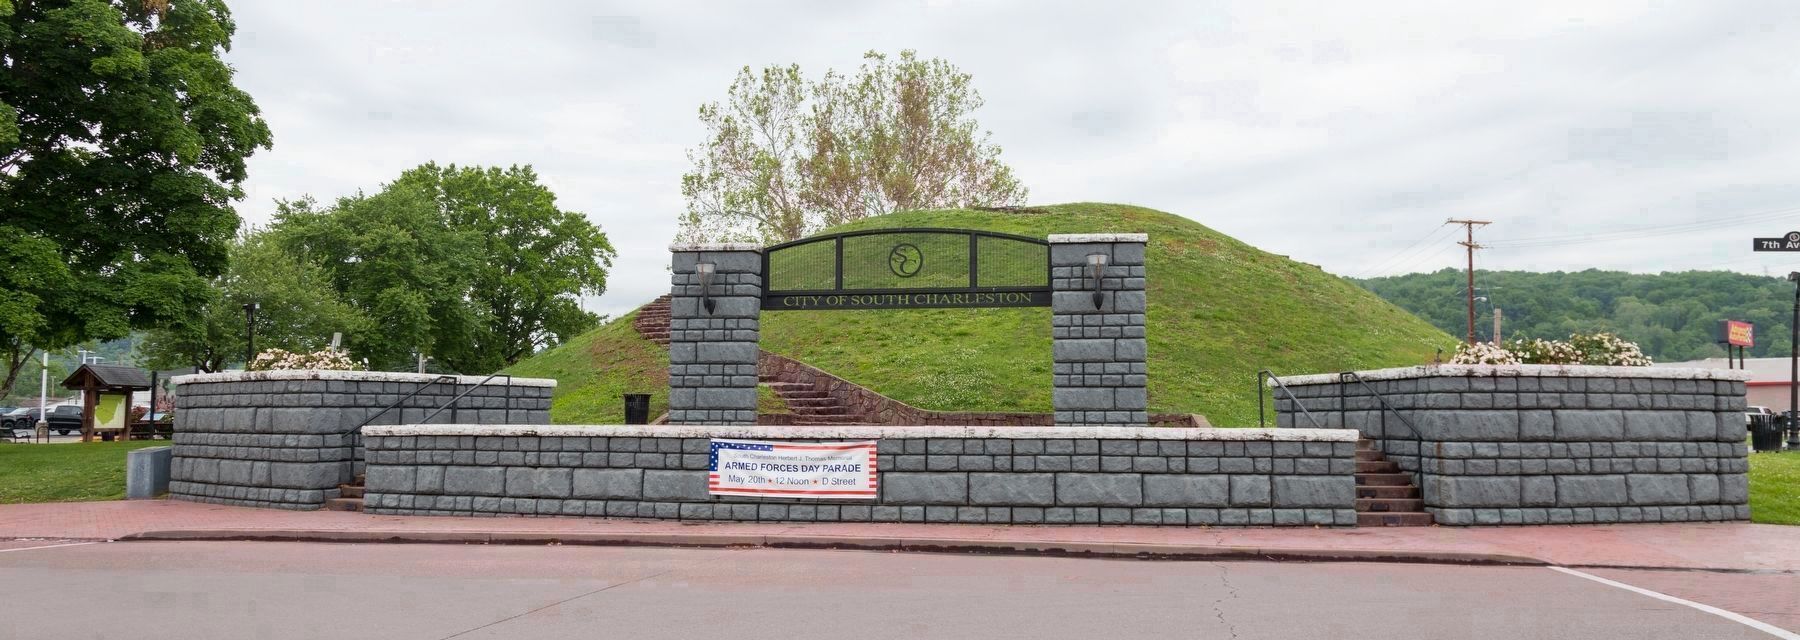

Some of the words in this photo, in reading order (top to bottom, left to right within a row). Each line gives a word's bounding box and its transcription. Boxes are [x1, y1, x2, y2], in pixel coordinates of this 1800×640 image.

[783, 295, 823, 307] CITY
[826, 295, 848, 306] OF
[851, 294, 909, 306] SOUTH
[914, 292, 1033, 305] CHARLESTON
[725, 462, 758, 471] ARMED
[760, 464, 799, 473] FORCES
[801, 465, 820, 473] DAY
[822, 464, 861, 473] PARADE
[729, 475, 745, 484] May
[748, 476, 766, 484] 20th
[775, 477, 785, 485] 12
[787, 478, 809, 486] Noon
[822, 477, 829, 486] D
[831, 477, 856, 486] Street
